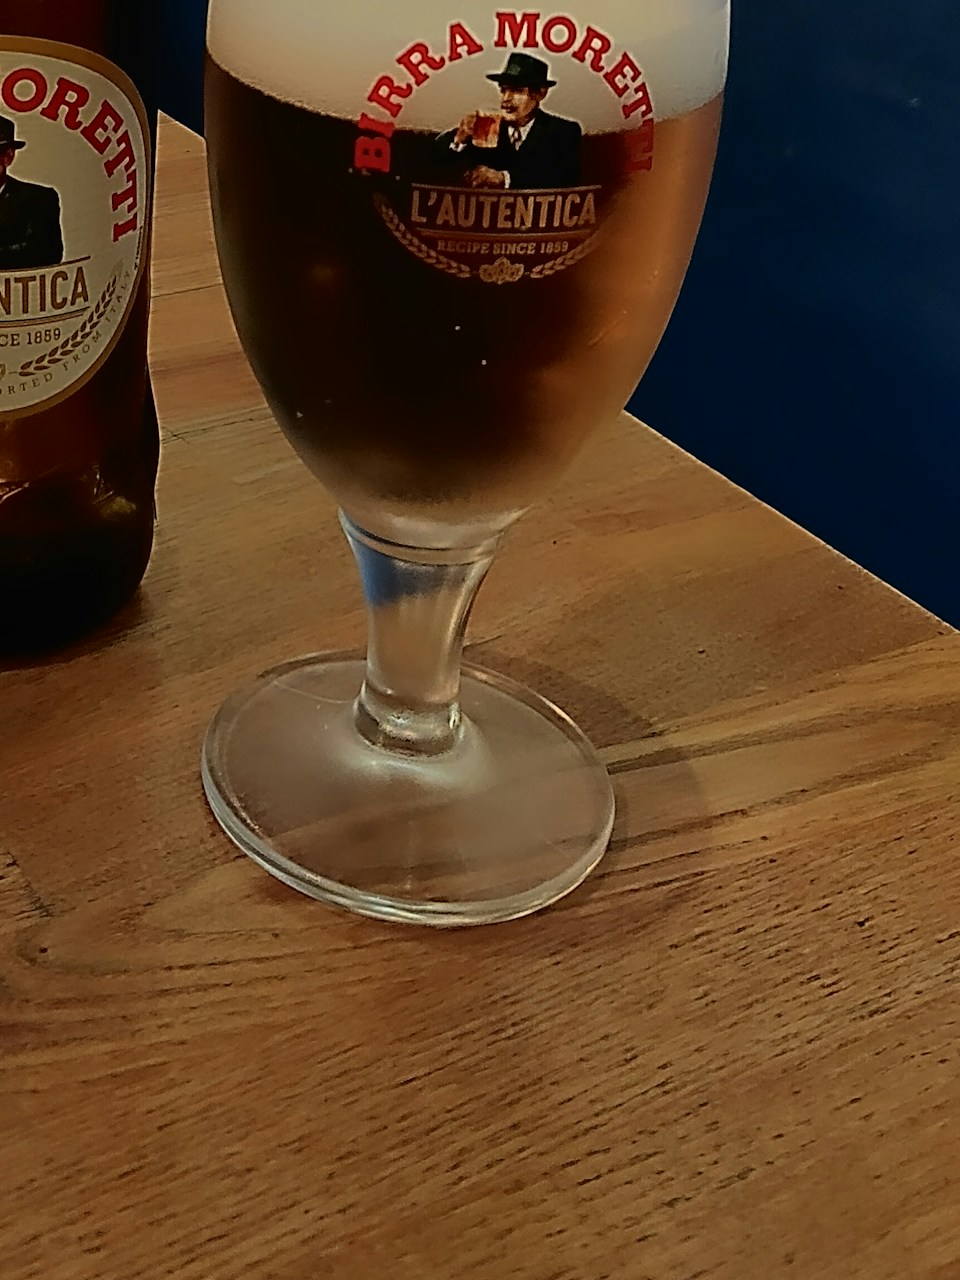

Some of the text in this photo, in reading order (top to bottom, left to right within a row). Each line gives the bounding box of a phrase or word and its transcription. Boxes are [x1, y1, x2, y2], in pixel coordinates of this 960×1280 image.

[353, 21, 484, 174] BIRRA
[410, 190, 597, 230] L'AUTENTICA
[437, 239, 490, 255] RECIPE
[492, 241, 536, 256] SINCE
[26, 326, 63, 346] 1859
[62, 330, 103, 372] FROM
